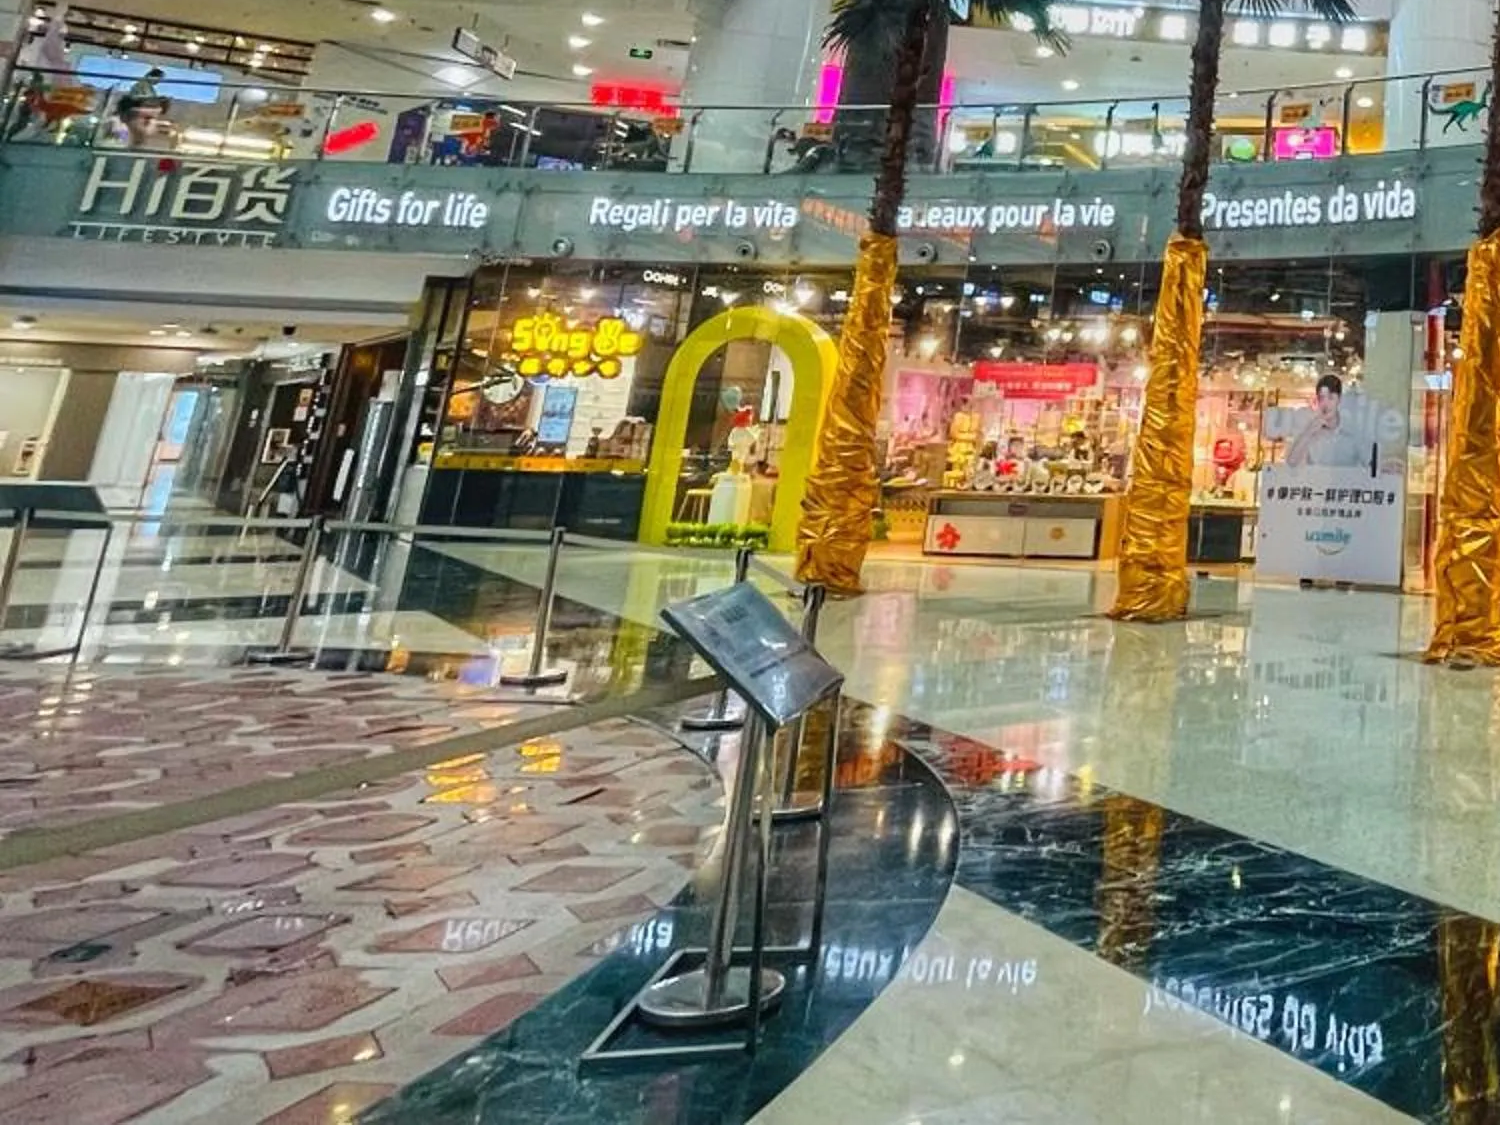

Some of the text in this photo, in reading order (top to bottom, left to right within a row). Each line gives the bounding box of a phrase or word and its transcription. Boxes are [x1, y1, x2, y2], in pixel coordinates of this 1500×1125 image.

[327, 187, 488, 229] Gifts for life
[590, 196, 798, 232] Regali per la vita
[988, 205, 1049, 234] pour
[1054, 198, 1078, 226] la
[1080, 197, 1116, 226] vie
[1200, 180, 1417, 228] Presentes da vida
